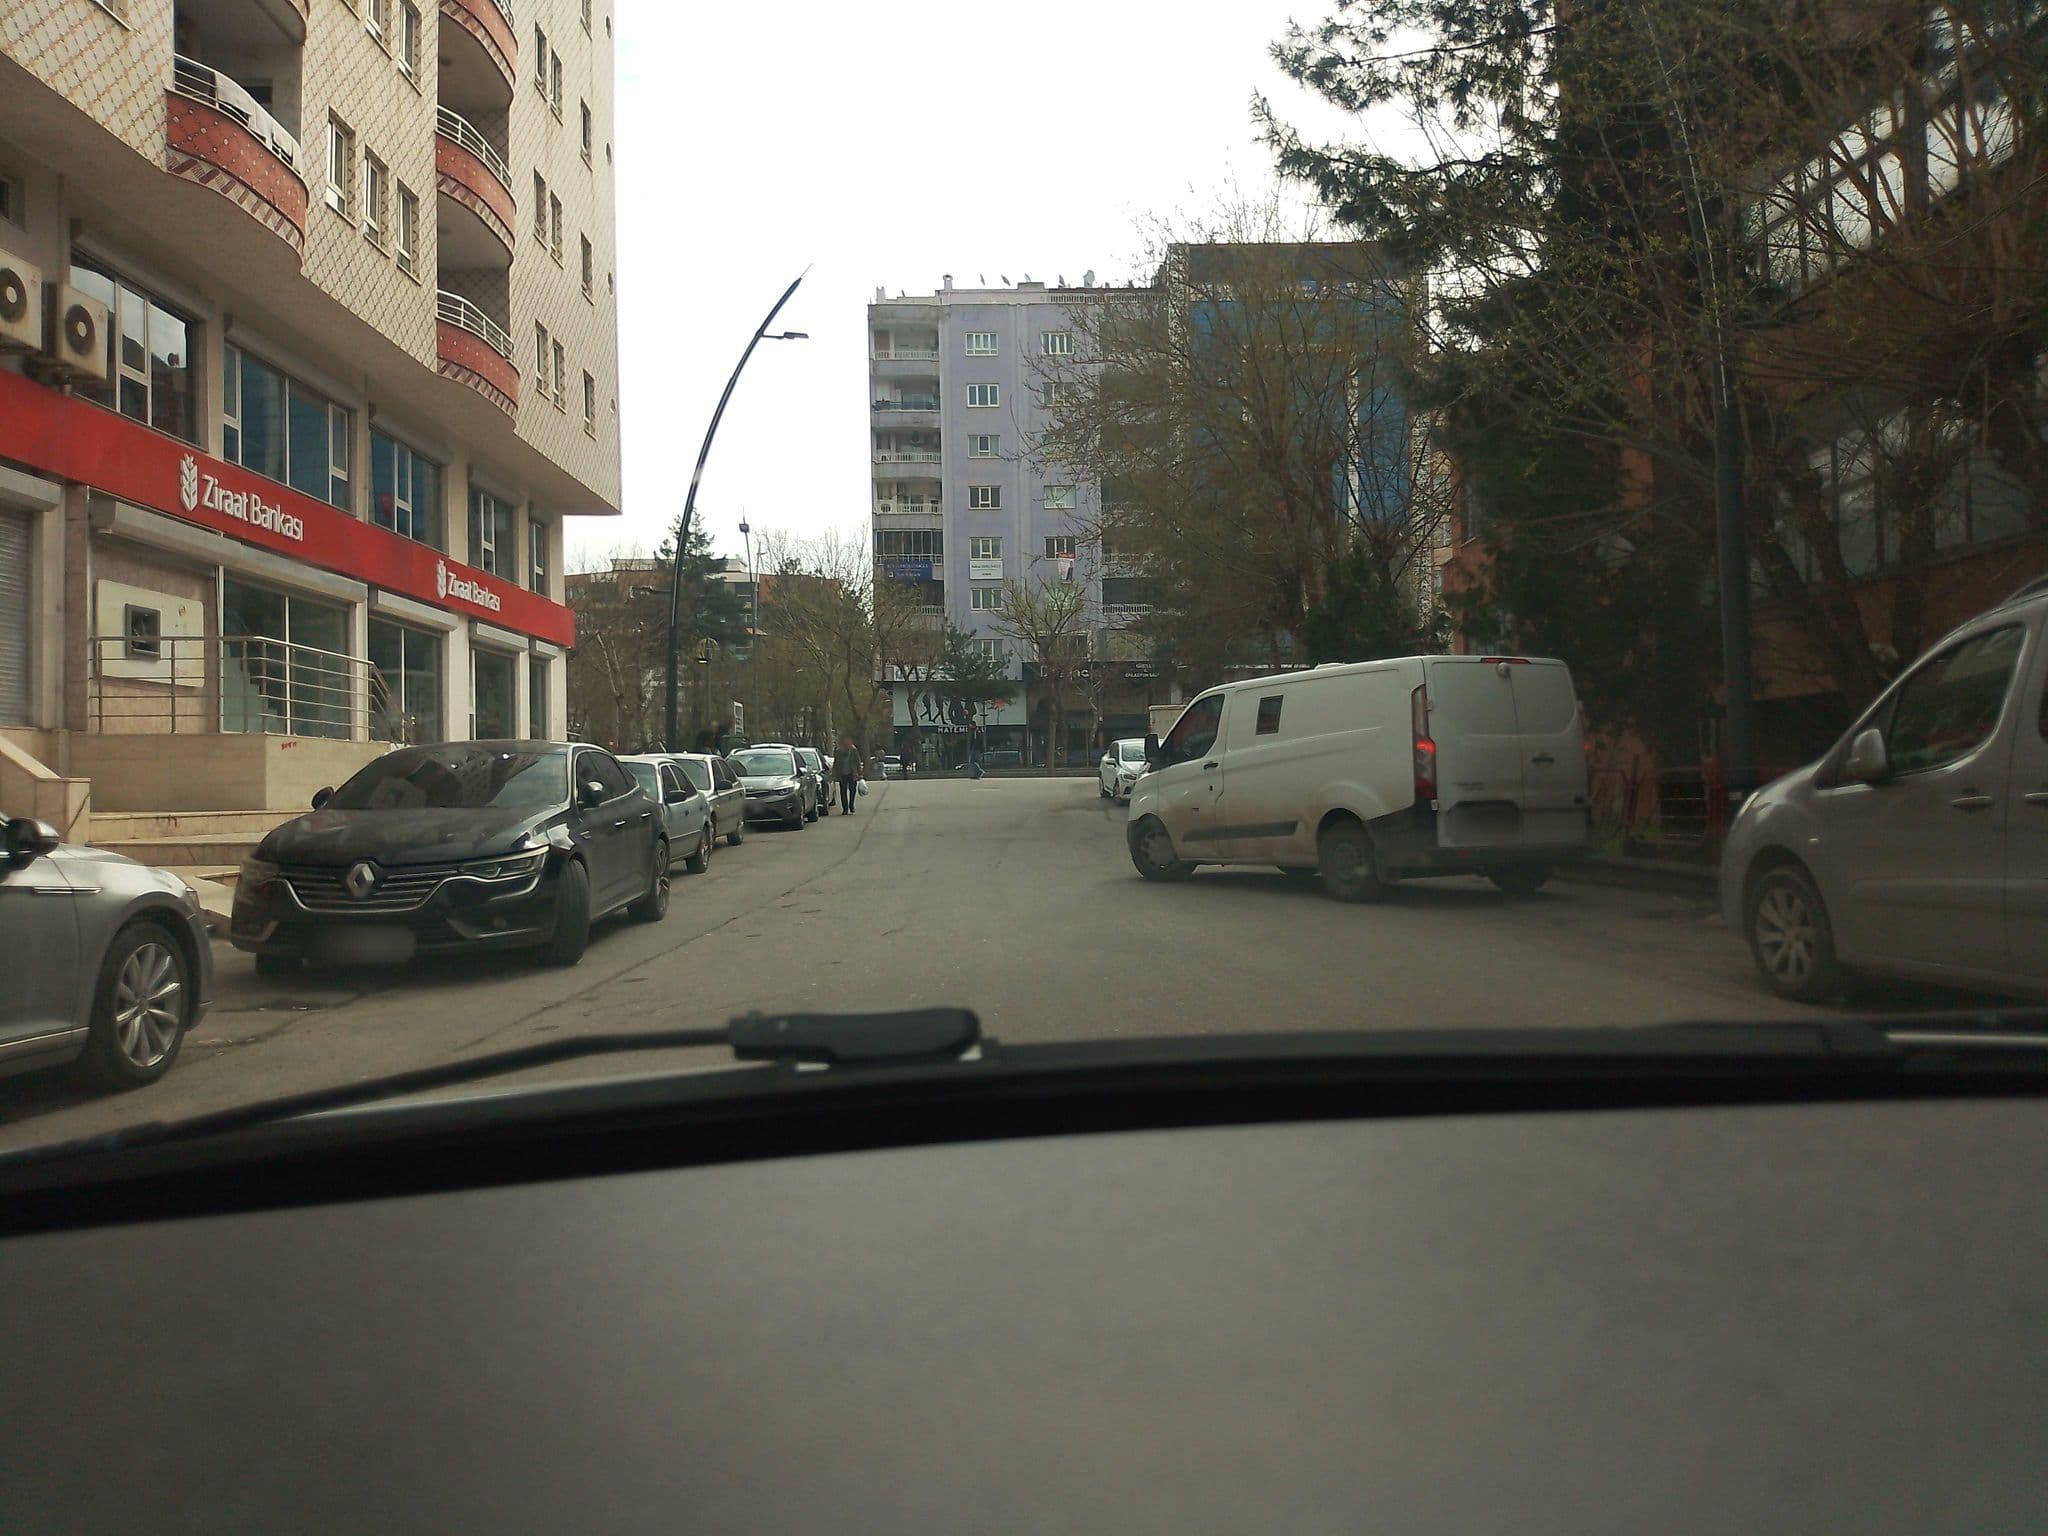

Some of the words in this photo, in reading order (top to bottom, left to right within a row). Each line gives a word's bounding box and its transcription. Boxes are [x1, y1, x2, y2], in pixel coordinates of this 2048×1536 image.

[201, 473, 249, 521] Ziraat
[249, 493, 304, 542] Bankası
[447, 571, 473, 602] Ziraat
